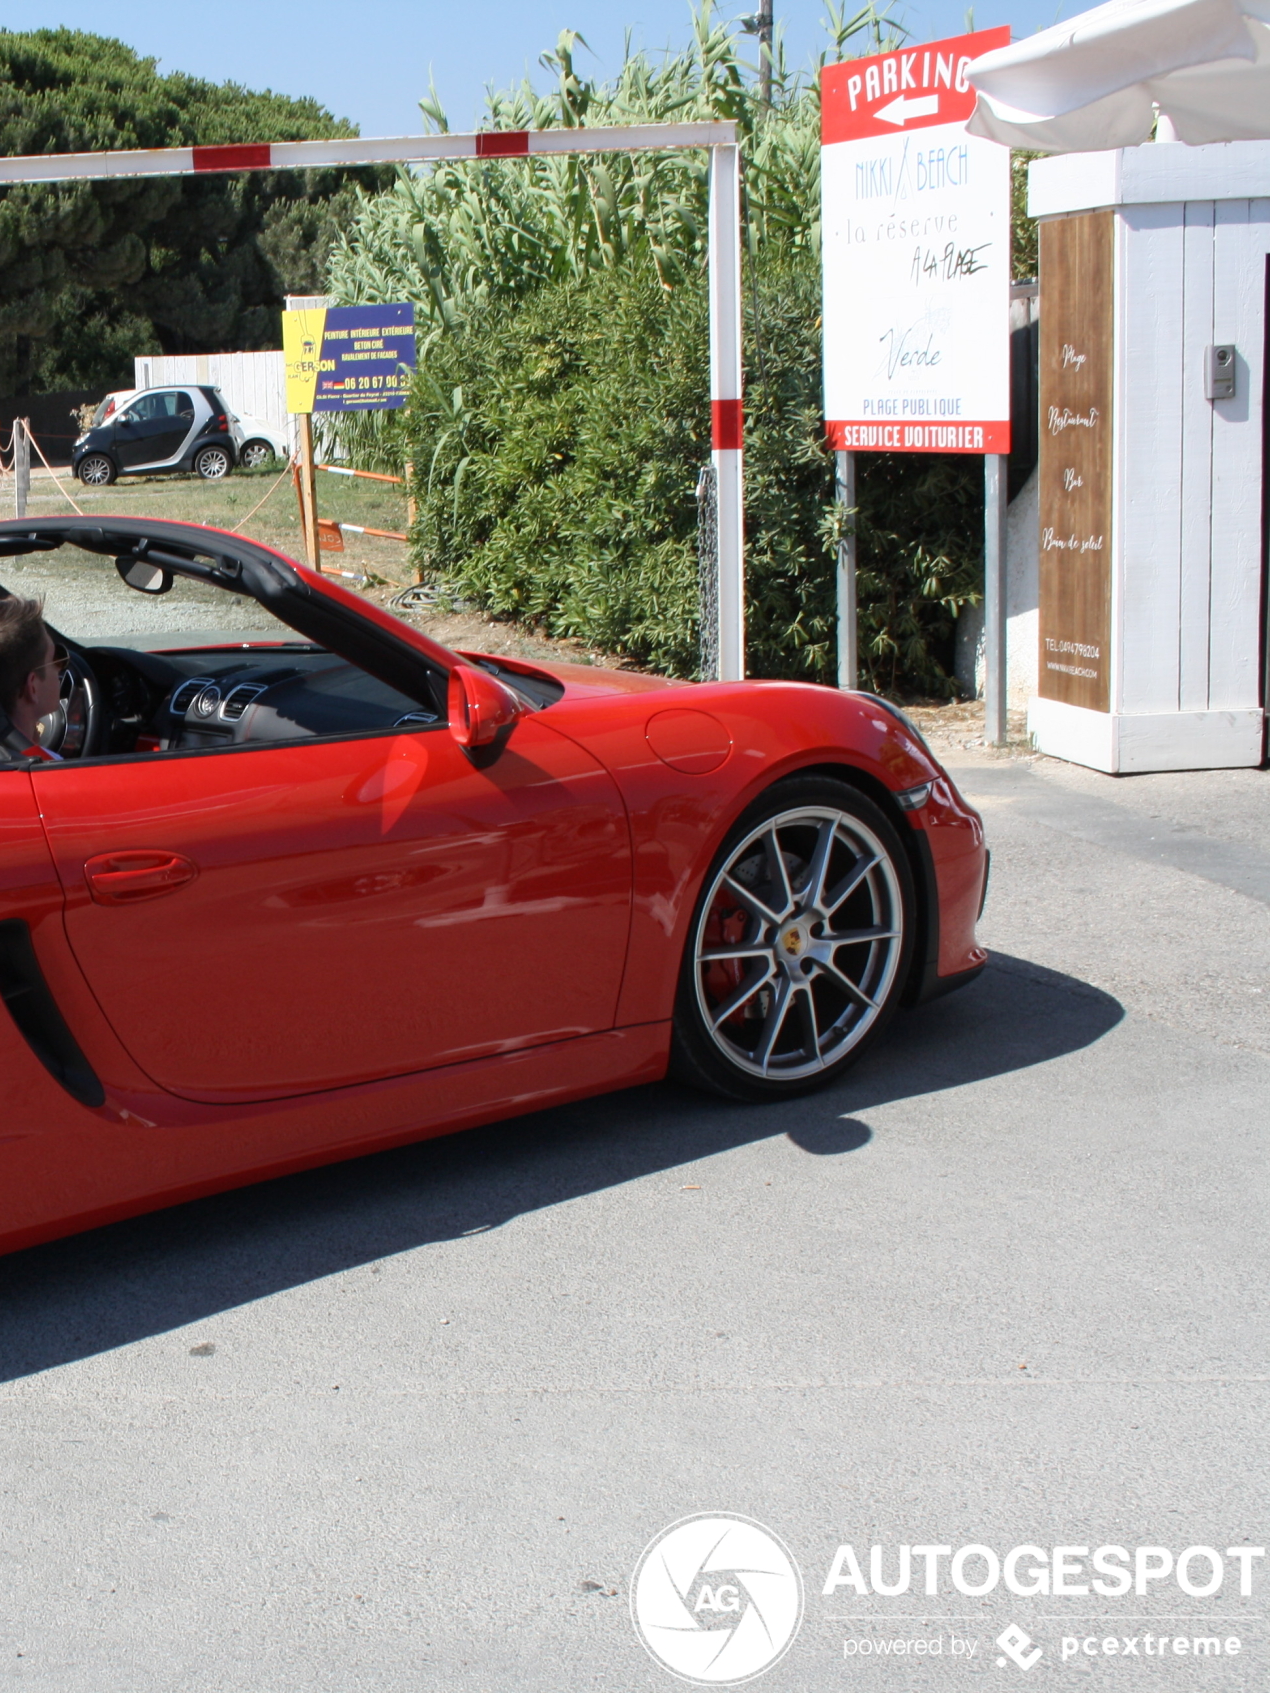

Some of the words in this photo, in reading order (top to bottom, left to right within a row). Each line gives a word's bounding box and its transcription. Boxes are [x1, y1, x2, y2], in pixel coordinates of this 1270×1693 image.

[848, 51, 972, 112] PARKING
[856, 157, 892, 200] NIKKI
[917, 144, 968, 191] BEACH
[847, 218, 866, 245] la
[877, 213, 958, 241] réserve
[939, 241, 993, 282] PLAGE
[294, 359, 336, 373] GERSON
[879, 328, 942, 380] Verde
[344, 377, 356, 390] 06
[359, 377, 370, 389] 20
[372, 376, 383, 389] 67
[863, 399, 898, 415] PLAGE
[902, 398, 962, 417] PUBLIQUE
[1048, 405, 1099, 436] Restaurant
[844, 425, 900, 446] SERVICE
[904, 426, 984, 448] VOITURIER
[1064, 467, 1084, 492] Bar
[1068, 533, 1080, 550] de
